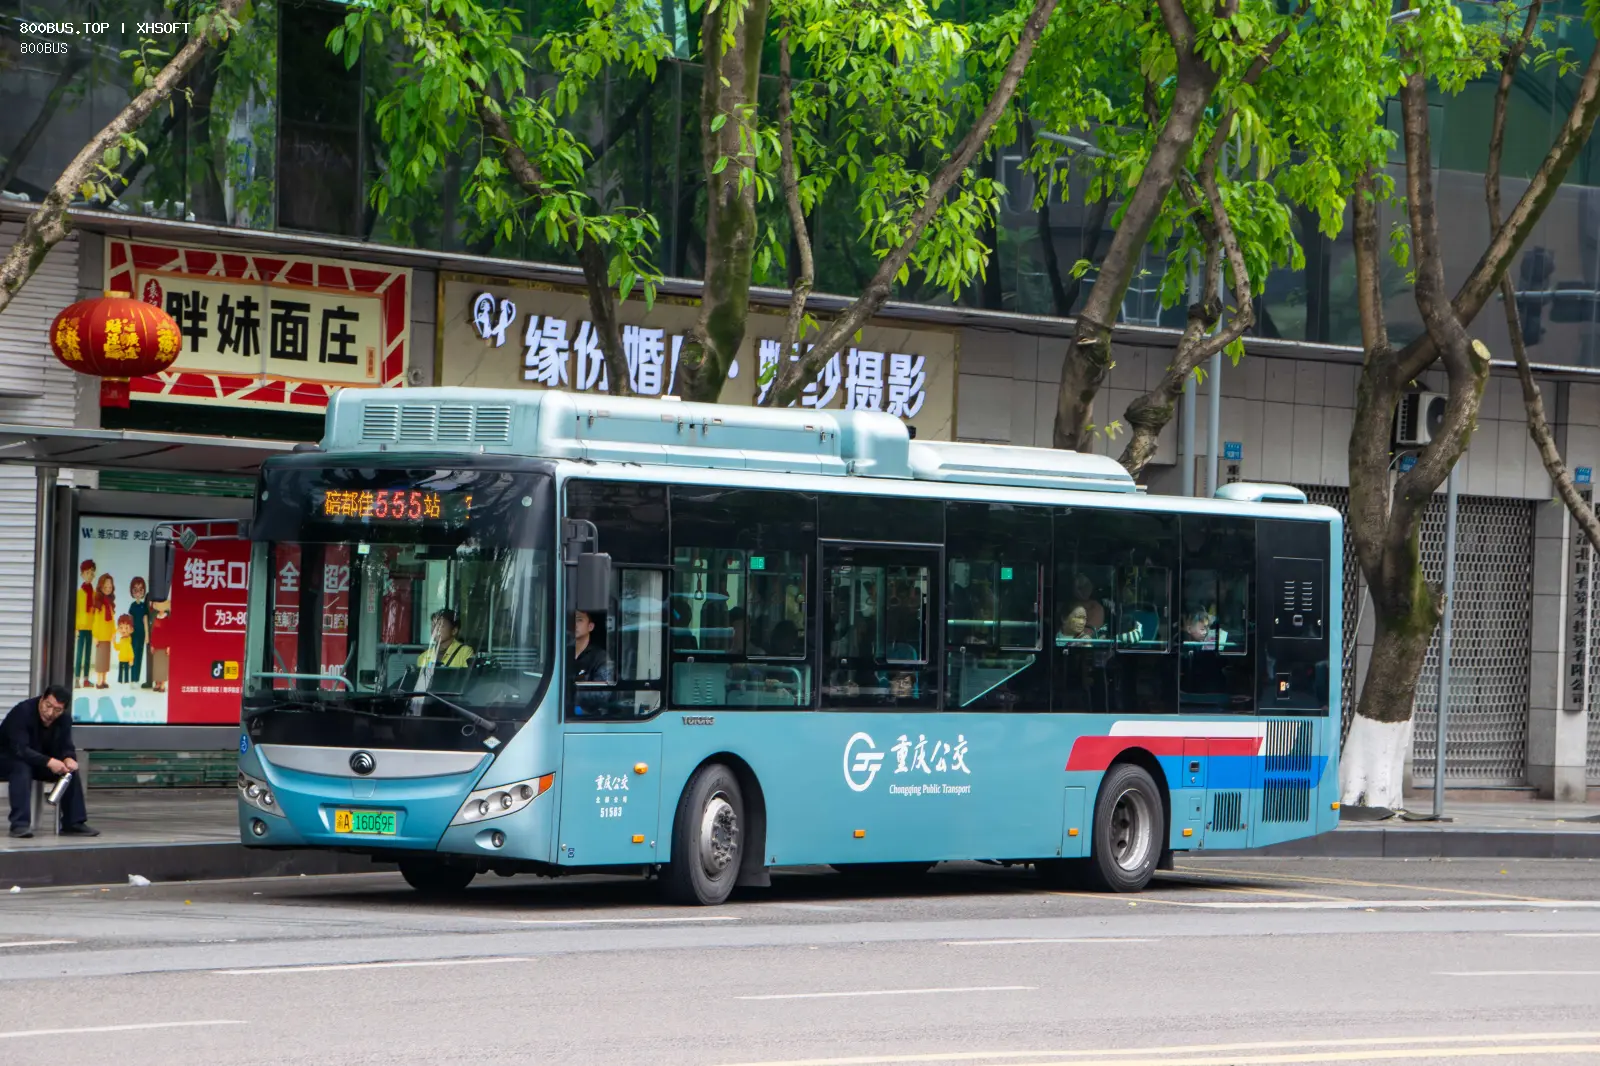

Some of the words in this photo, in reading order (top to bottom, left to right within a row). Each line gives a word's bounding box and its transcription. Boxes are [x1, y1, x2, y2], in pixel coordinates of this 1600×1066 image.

[166, 290, 360, 366] 胖妹面庄
[183, 557, 252, 590] 维乐口
[890, 733, 972, 774] 重庆公交
[594, 773, 630, 791] 重庆公交
[889, 784, 922, 796] Chongqing
[922, 784, 941, 794] Public
[941, 784, 971, 796] Transport
